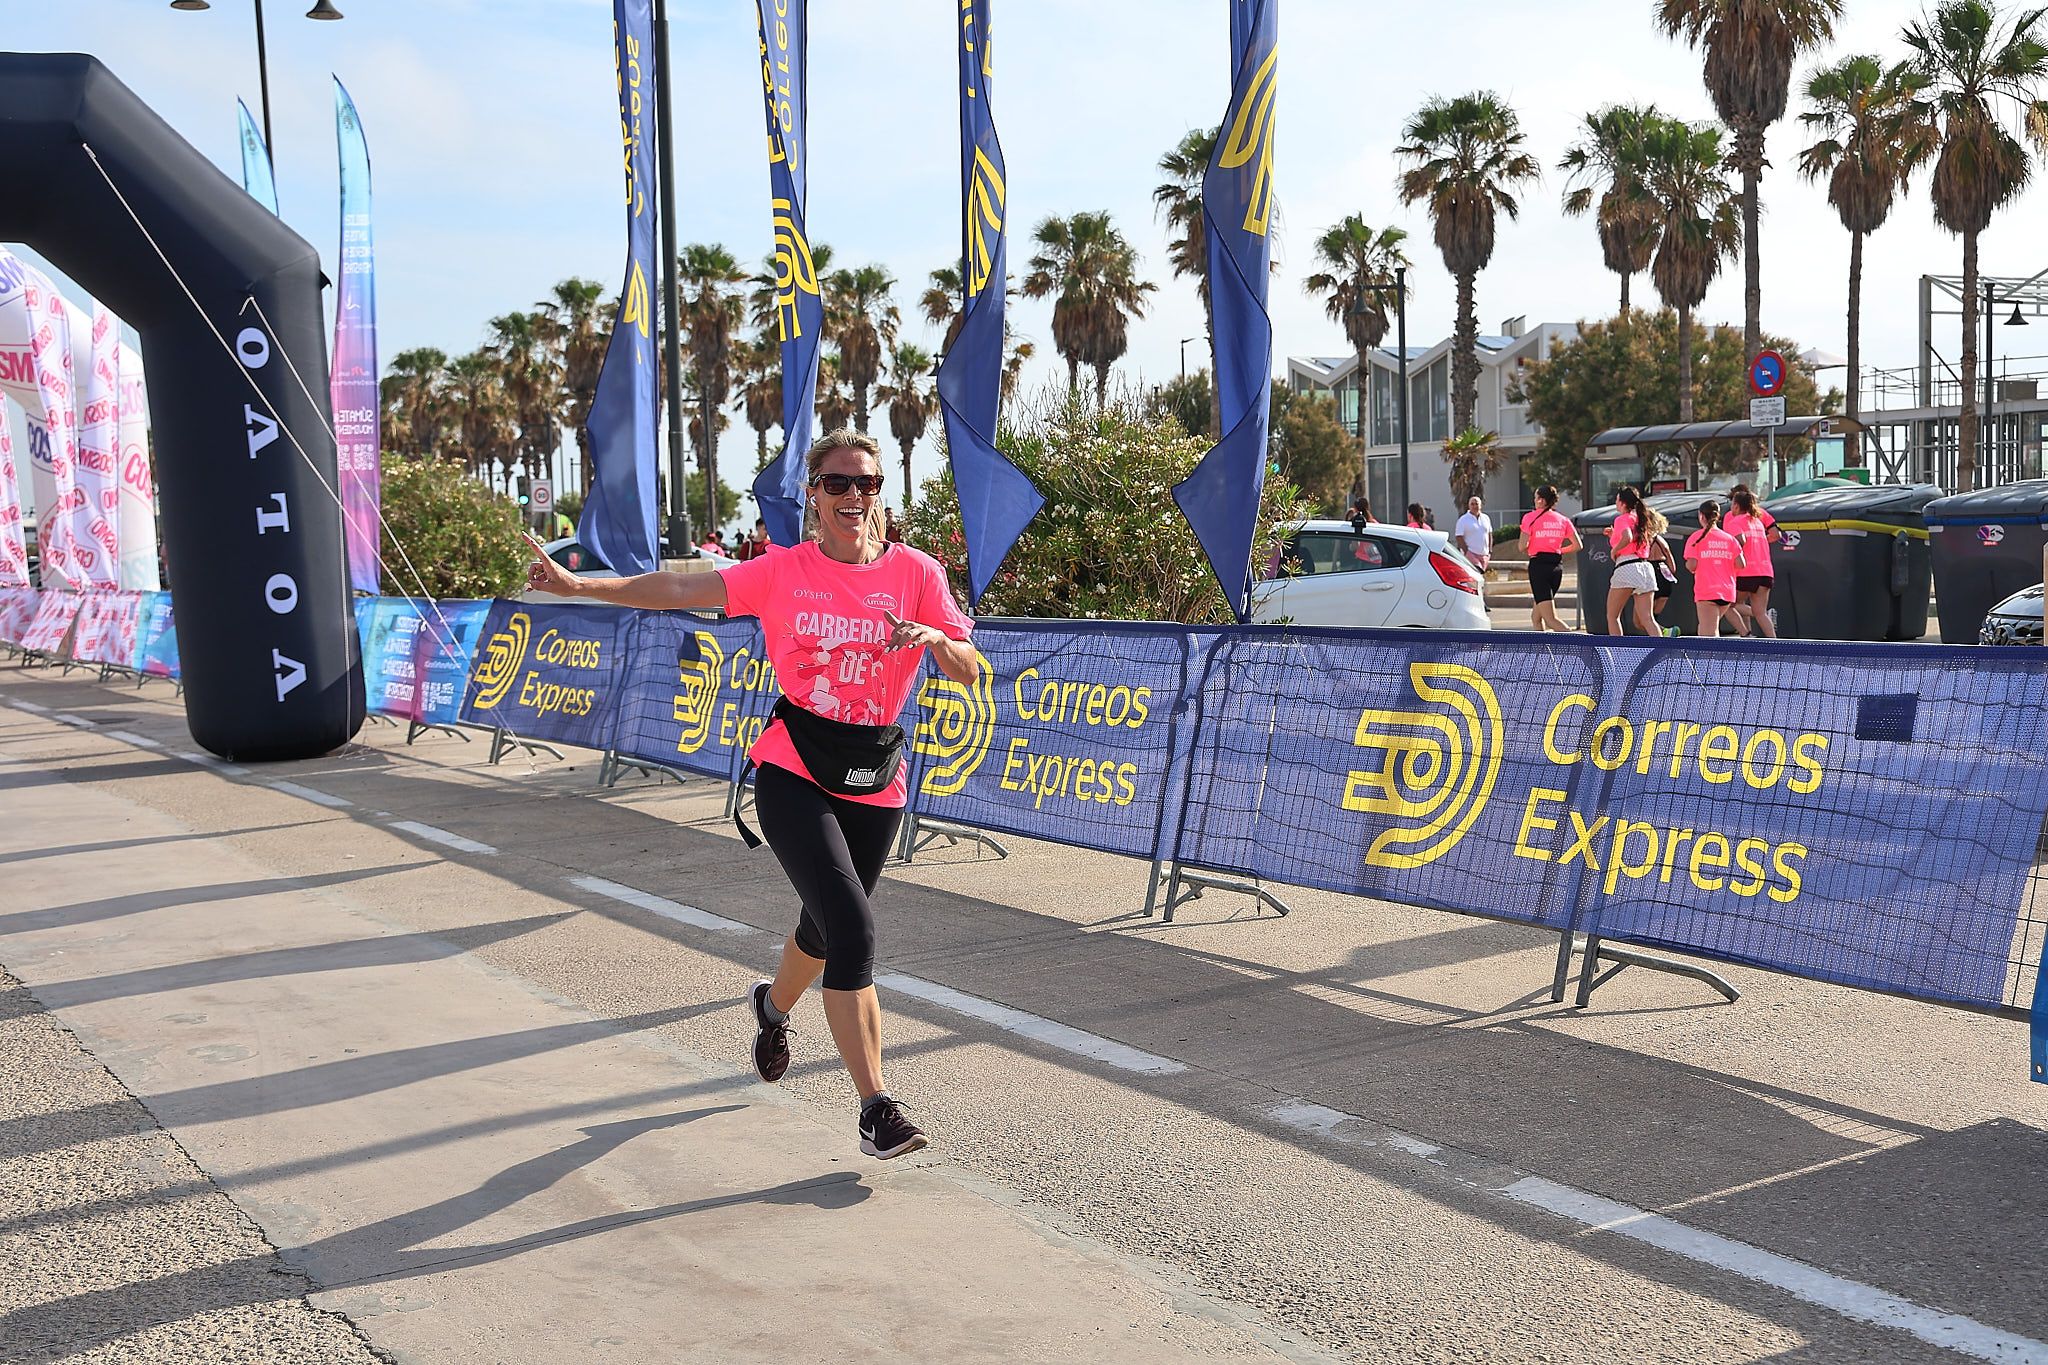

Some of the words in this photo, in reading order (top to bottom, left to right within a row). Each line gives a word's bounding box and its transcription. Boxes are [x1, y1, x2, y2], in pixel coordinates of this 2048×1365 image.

[236, 327, 307, 702] VOLVO
[794, 589, 833, 601] OYSHO
[535, 628, 602, 669] Correos
[795, 612, 887, 646] CARRERA
[519, 671, 596, 718] Express
[839, 650, 872, 685] DE
[1014, 667, 1152, 729] Correos
[1543, 693, 1831, 794] Correos
[1000, 737, 1138, 810] Express
[1513, 787, 1808, 902] Express
